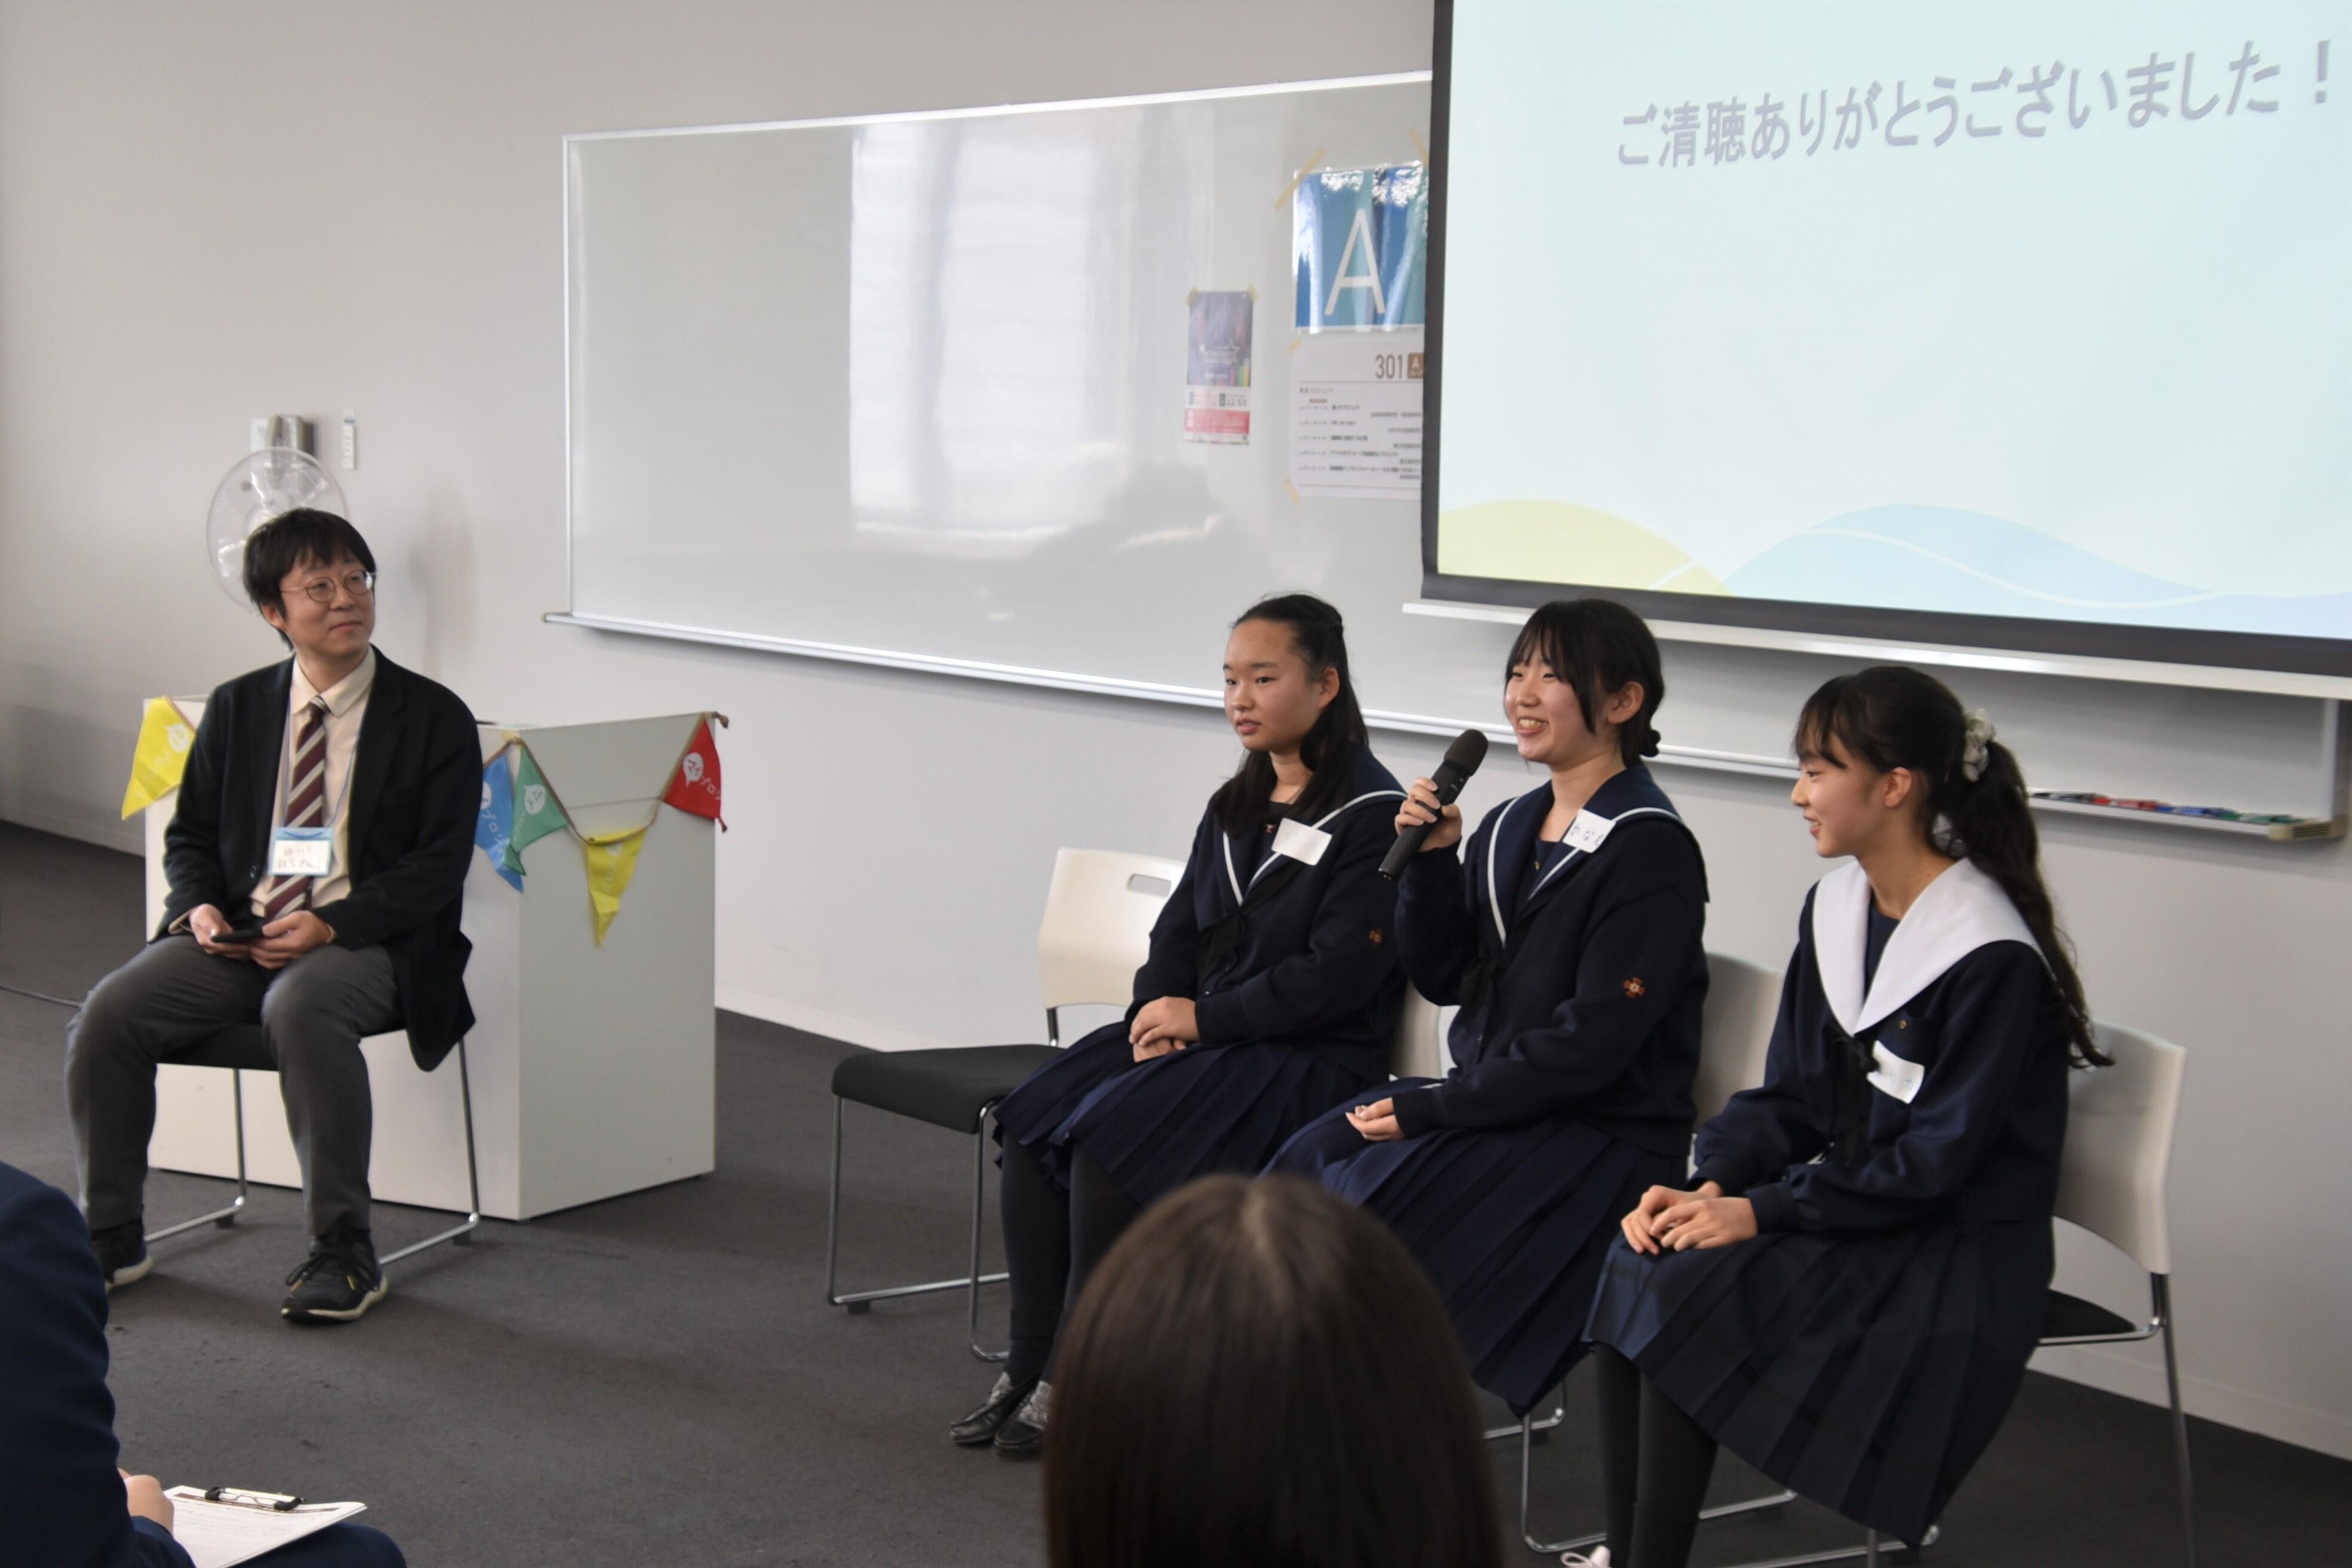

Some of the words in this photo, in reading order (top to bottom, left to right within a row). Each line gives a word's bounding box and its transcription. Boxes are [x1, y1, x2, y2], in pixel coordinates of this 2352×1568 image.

[1618, 39, 2331, 168] ご清聴ありがとうございました！
[1324, 208, 1386, 316] A
[1375, 354, 1402, 379] 301
